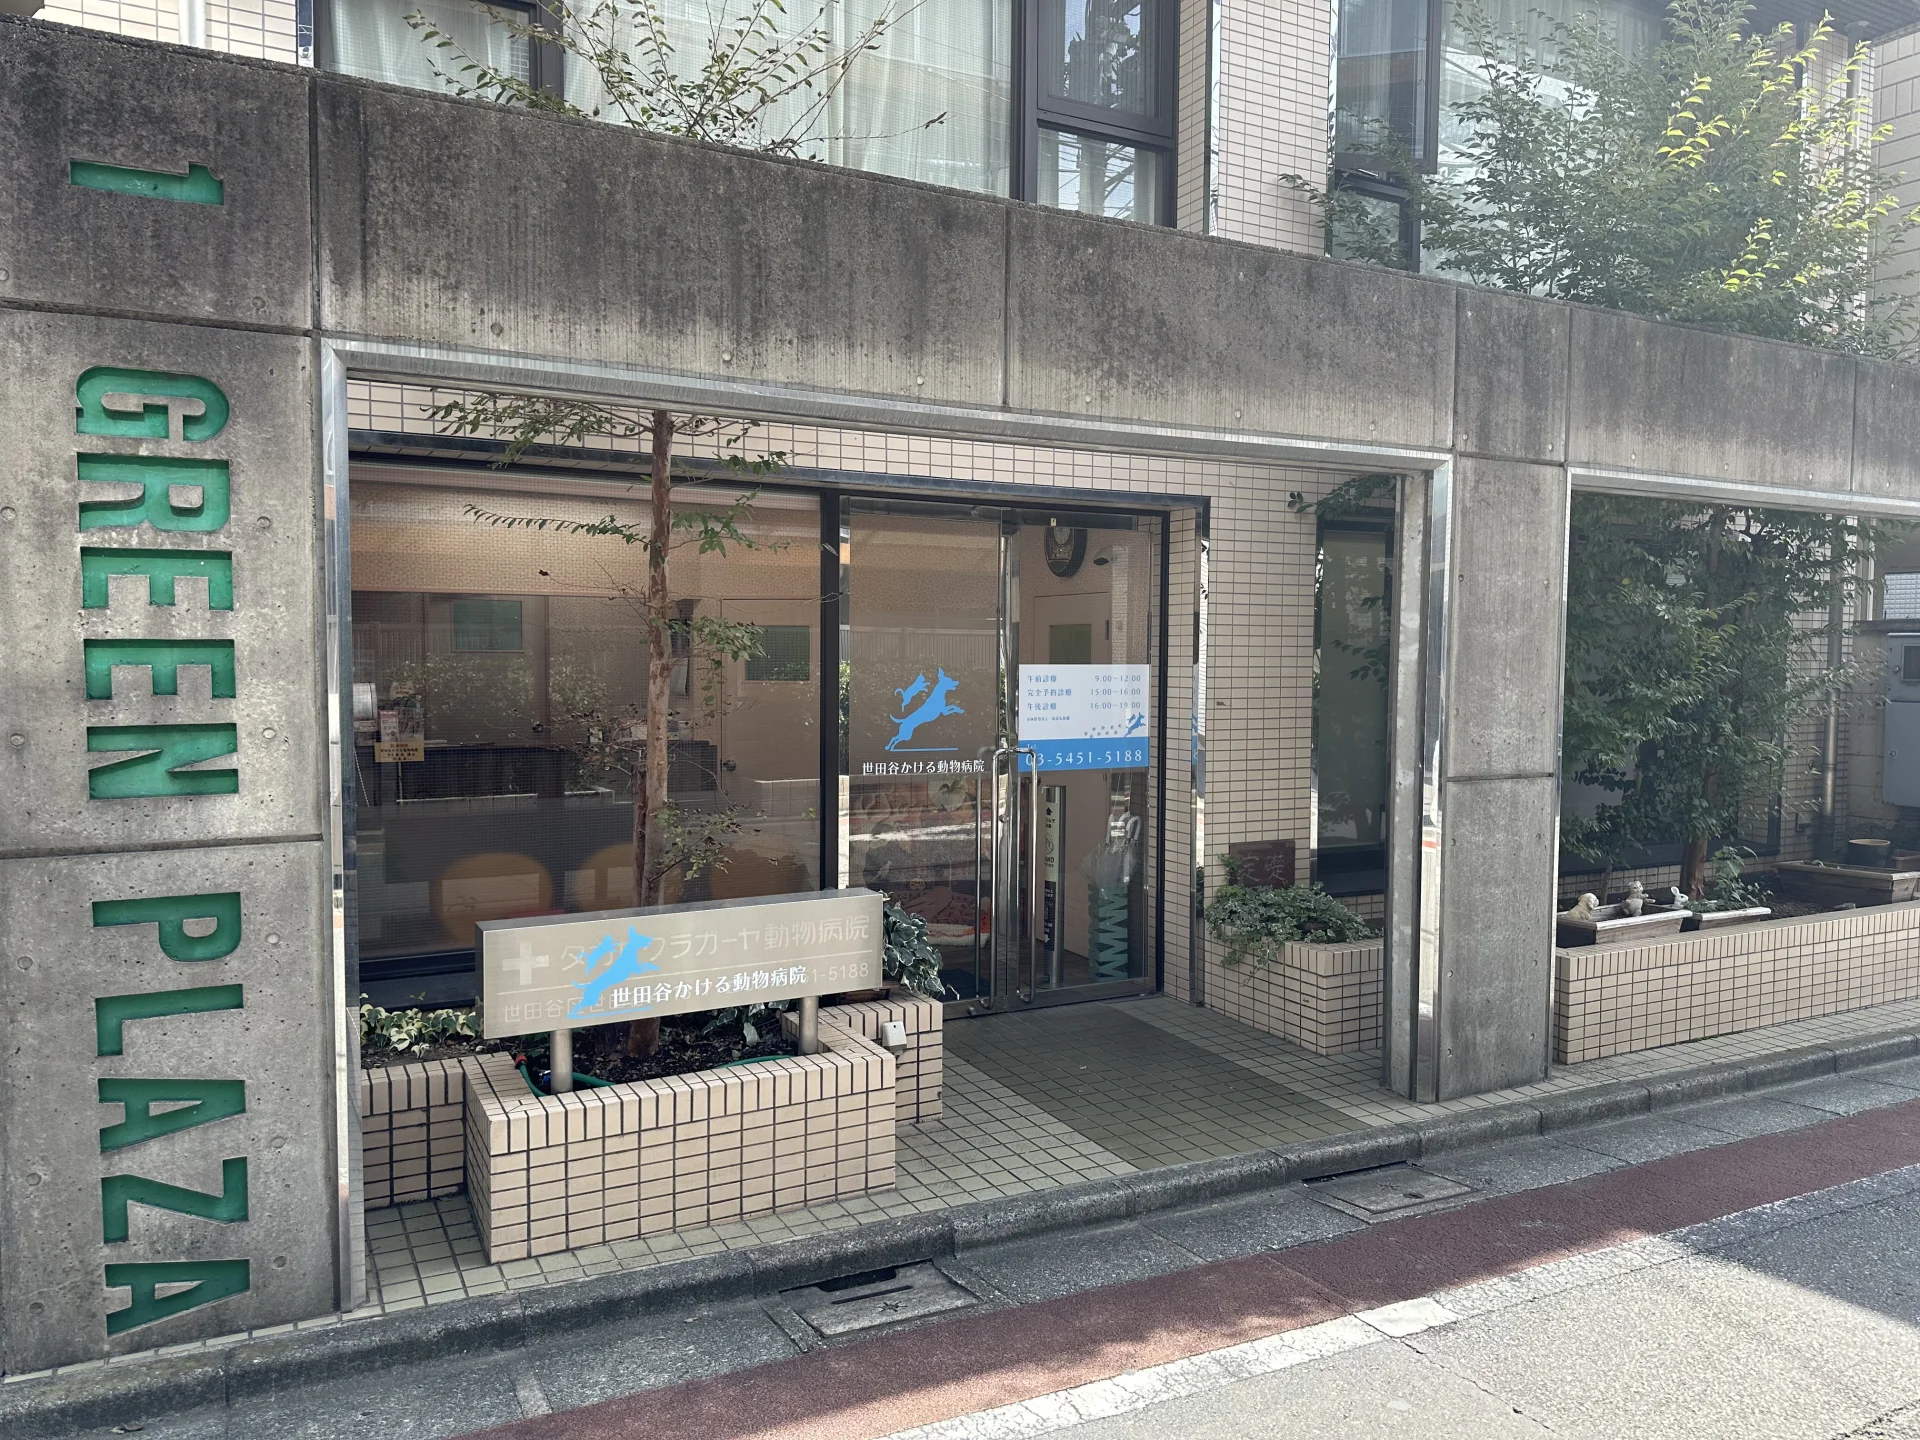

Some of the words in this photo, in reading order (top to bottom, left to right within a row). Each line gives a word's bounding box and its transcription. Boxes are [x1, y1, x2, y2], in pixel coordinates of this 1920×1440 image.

[70, 158, 225, 206] 1
[75, 366, 239, 800] GREEN
[862, 760, 985, 776] 世田谷かける動物病院
[1025, 749, 1142, 767] 03-5451-5188
[611, 964, 807, 1009] 世田谷かける動物病院
[92, 891, 251, 1338] PLAZA
